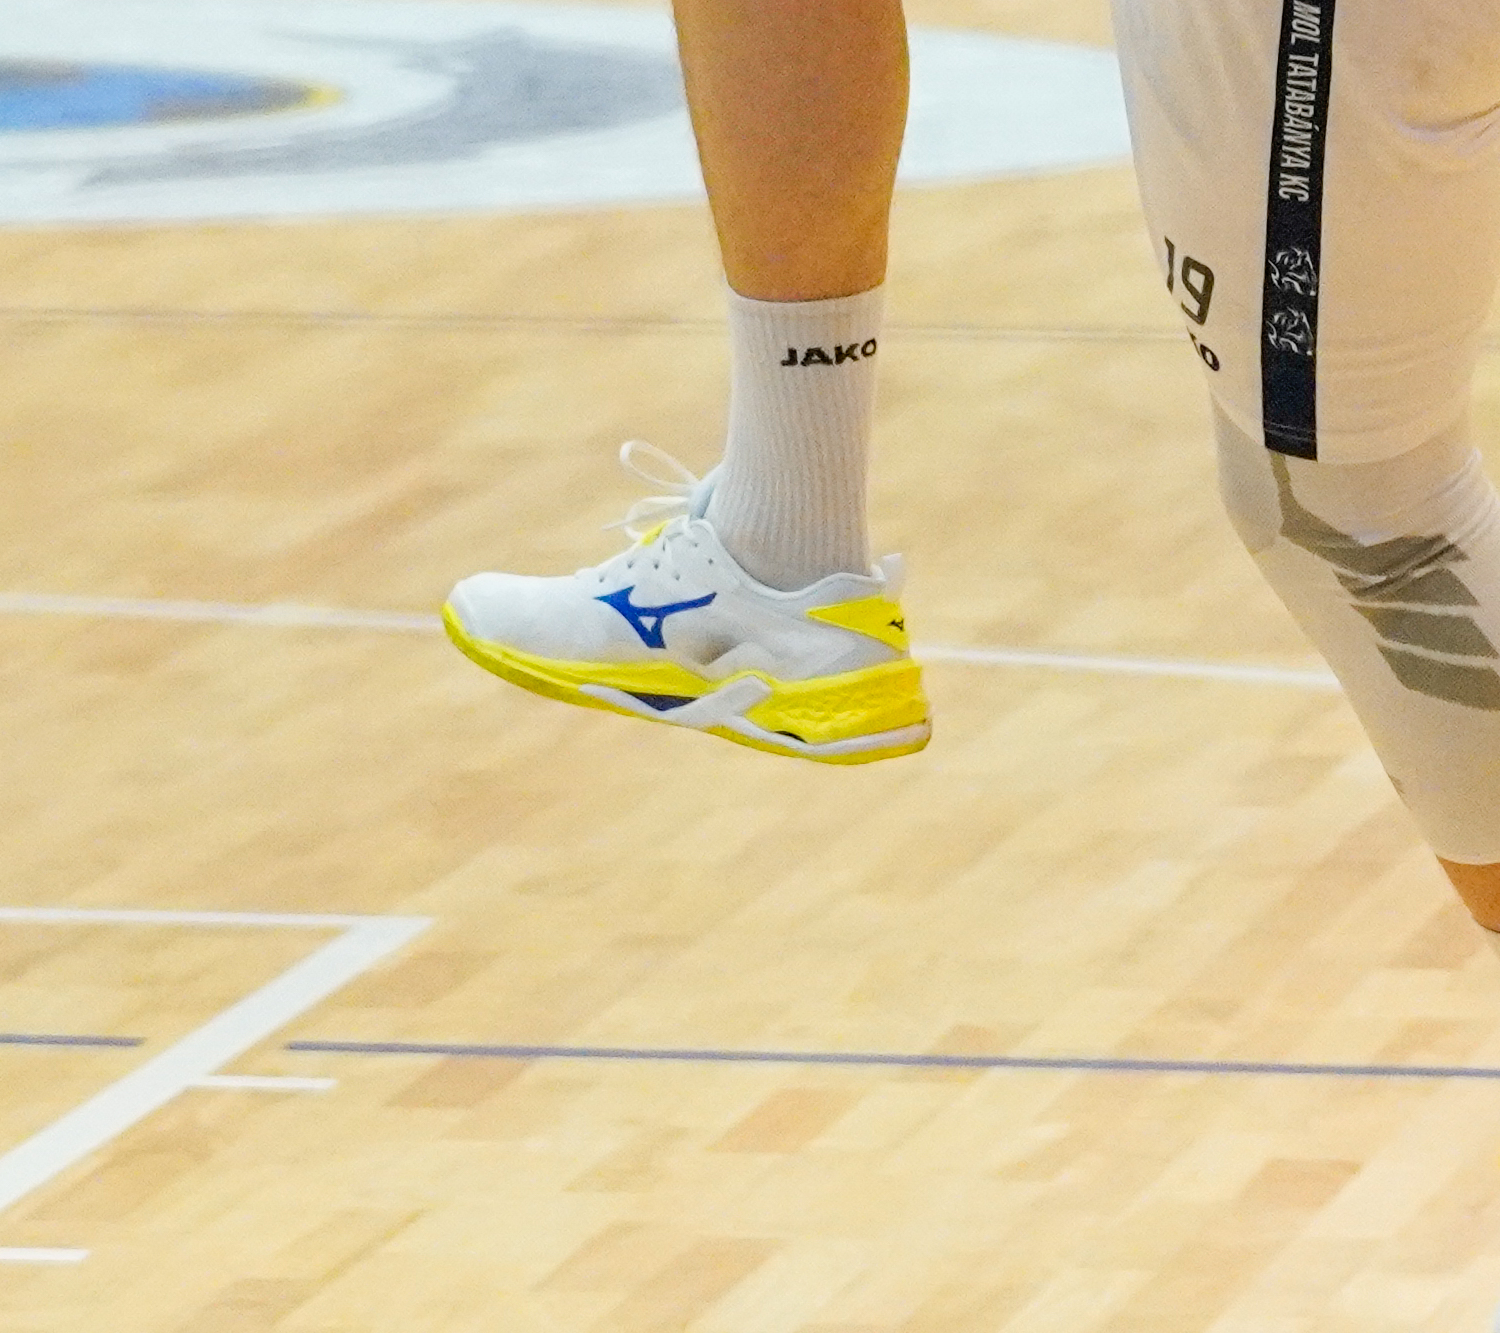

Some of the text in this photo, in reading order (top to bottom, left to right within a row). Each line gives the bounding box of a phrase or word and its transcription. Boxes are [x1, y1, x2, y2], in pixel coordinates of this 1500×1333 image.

[1278, 0, 1321, 202] MOL TATABÁNYA KC
[1164, 235, 1215, 326] 19
[781, 338, 877, 367] JAKO
